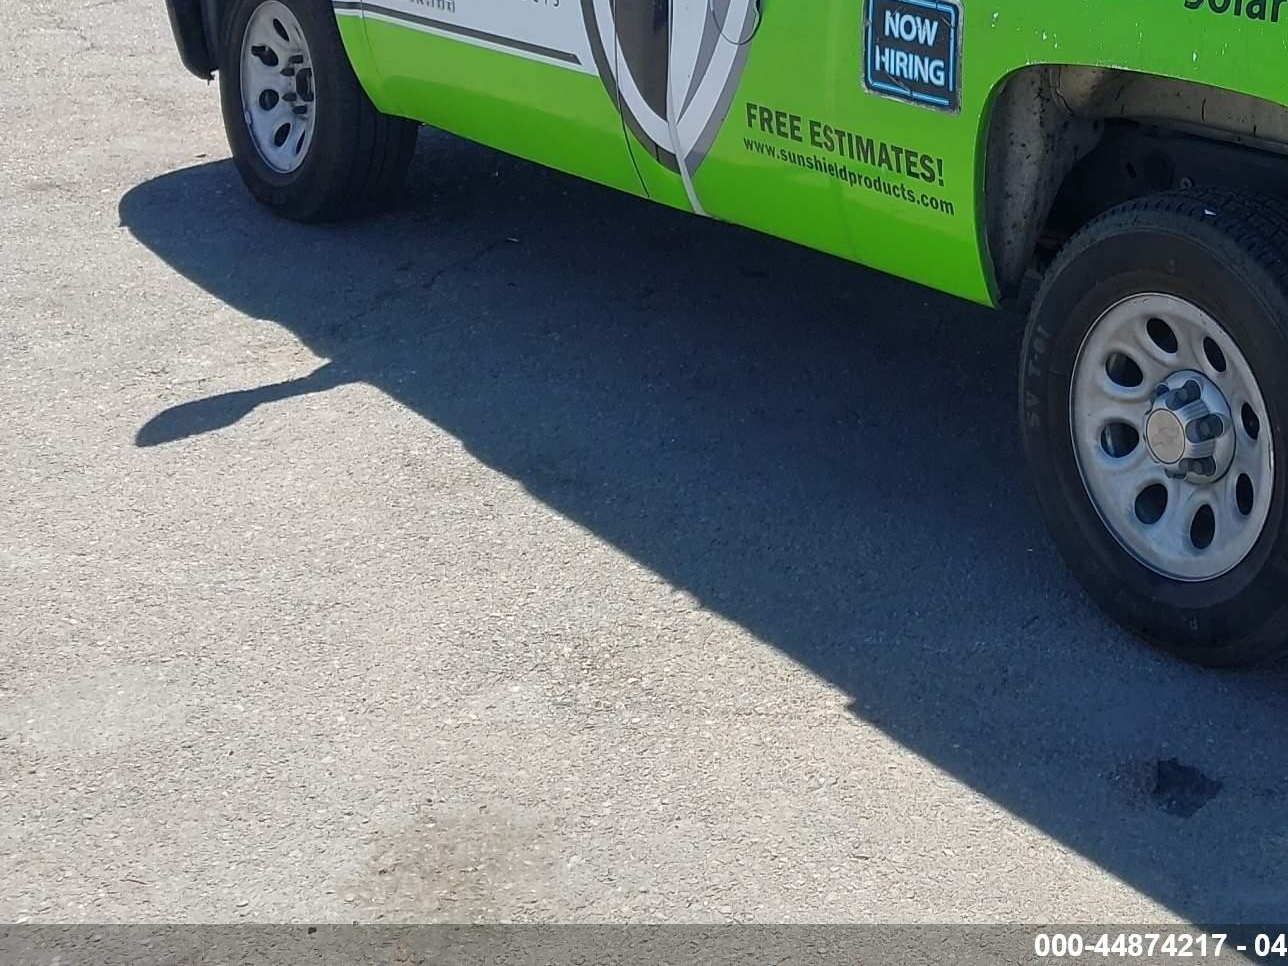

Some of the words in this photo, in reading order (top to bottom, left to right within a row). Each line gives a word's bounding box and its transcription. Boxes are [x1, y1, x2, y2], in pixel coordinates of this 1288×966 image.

[884, 9, 938, 47] NOW
[875, 45, 945, 86] HIRING
[746, 102, 803, 142] FREE
[809, 120, 945, 187] ESTIMATES!
[743, 137, 955, 216] www.sunshieldproducts.com
